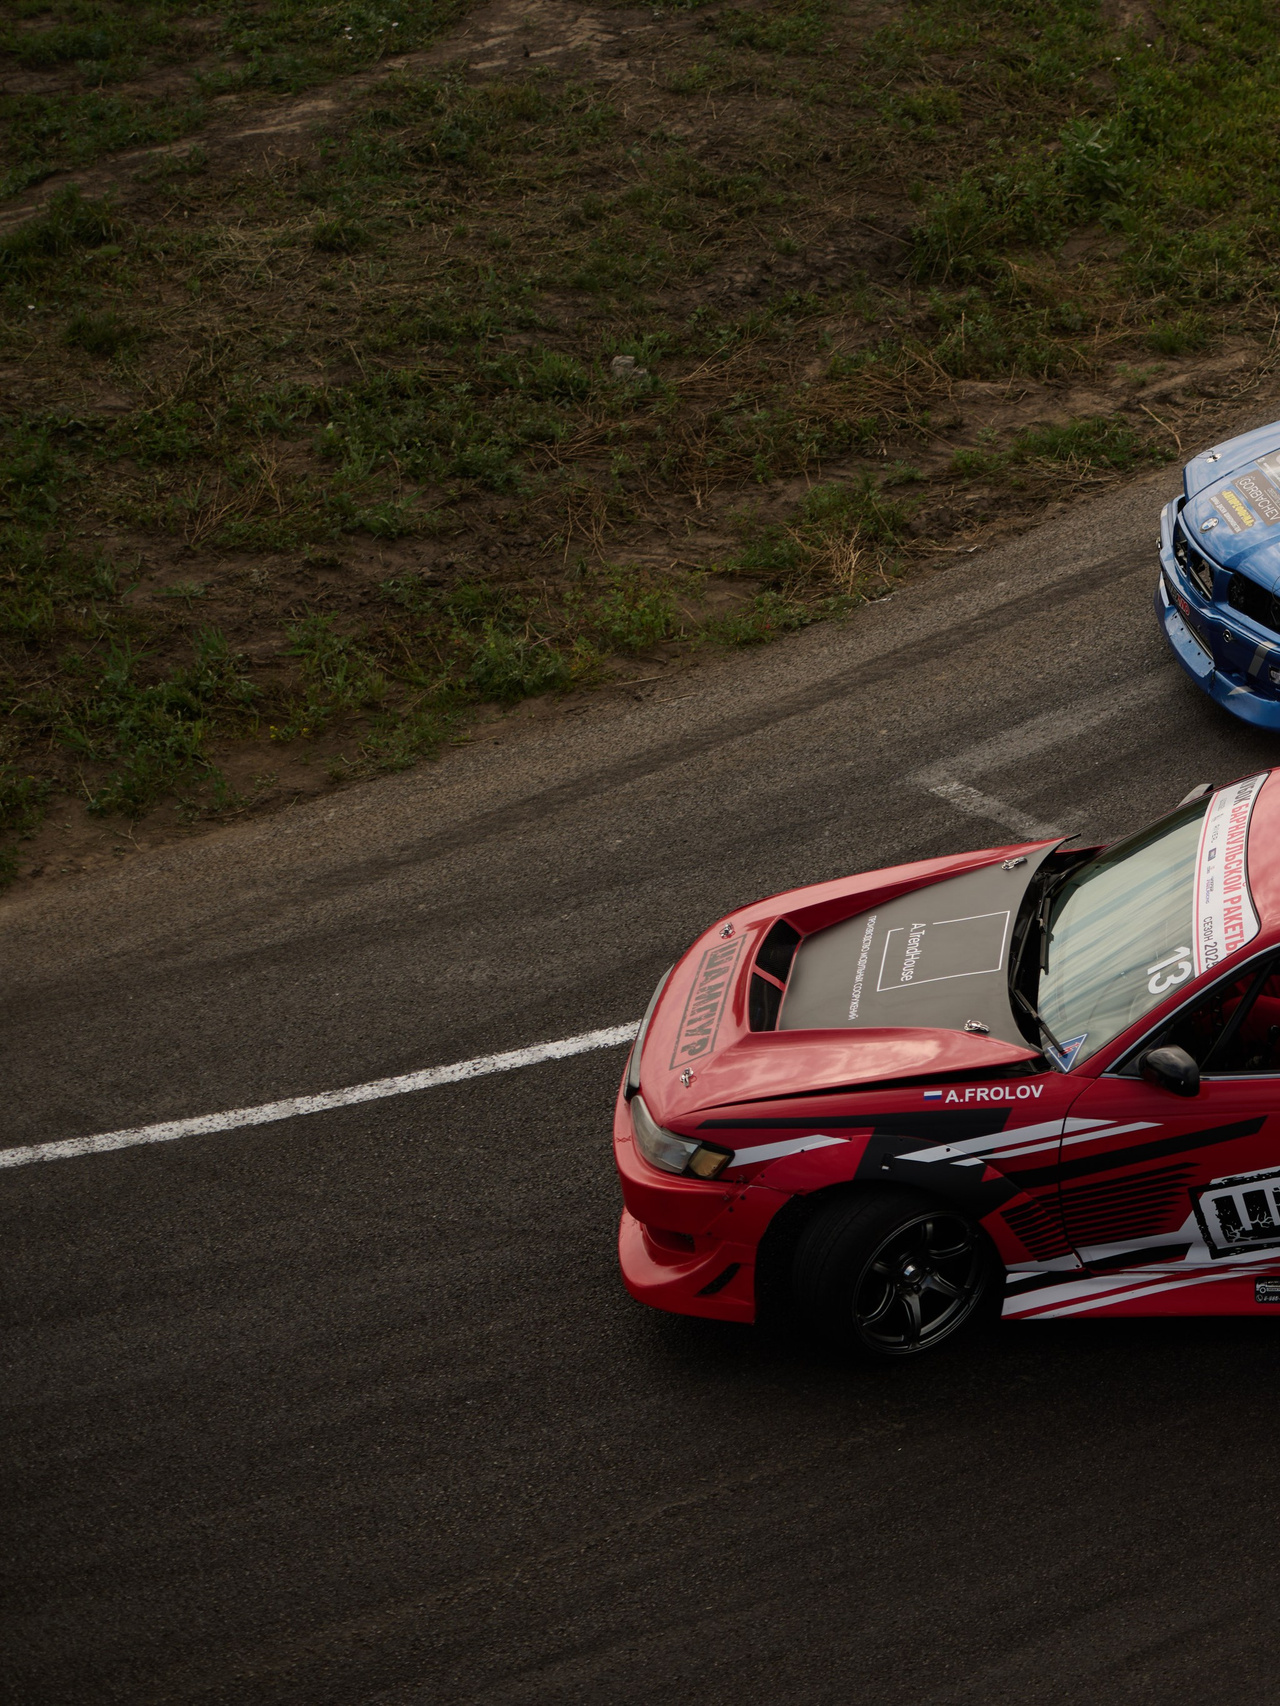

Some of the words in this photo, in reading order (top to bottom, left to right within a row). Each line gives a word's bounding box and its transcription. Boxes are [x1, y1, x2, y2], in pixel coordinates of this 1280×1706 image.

[1233, 777, 1258, 806] УБОК
[1223, 802, 1249, 895] БАРНАУЛЬСКОЙ
[901, 923, 926, 982] A.TrendHouse
[1203, 916, 1214, 942] СЕЗОН
[1147, 946, 1192, 994] 13
[681, 943, 738, 1056] ШАМПУР
[945, 1084, 1044, 1103] A.FROLOV
